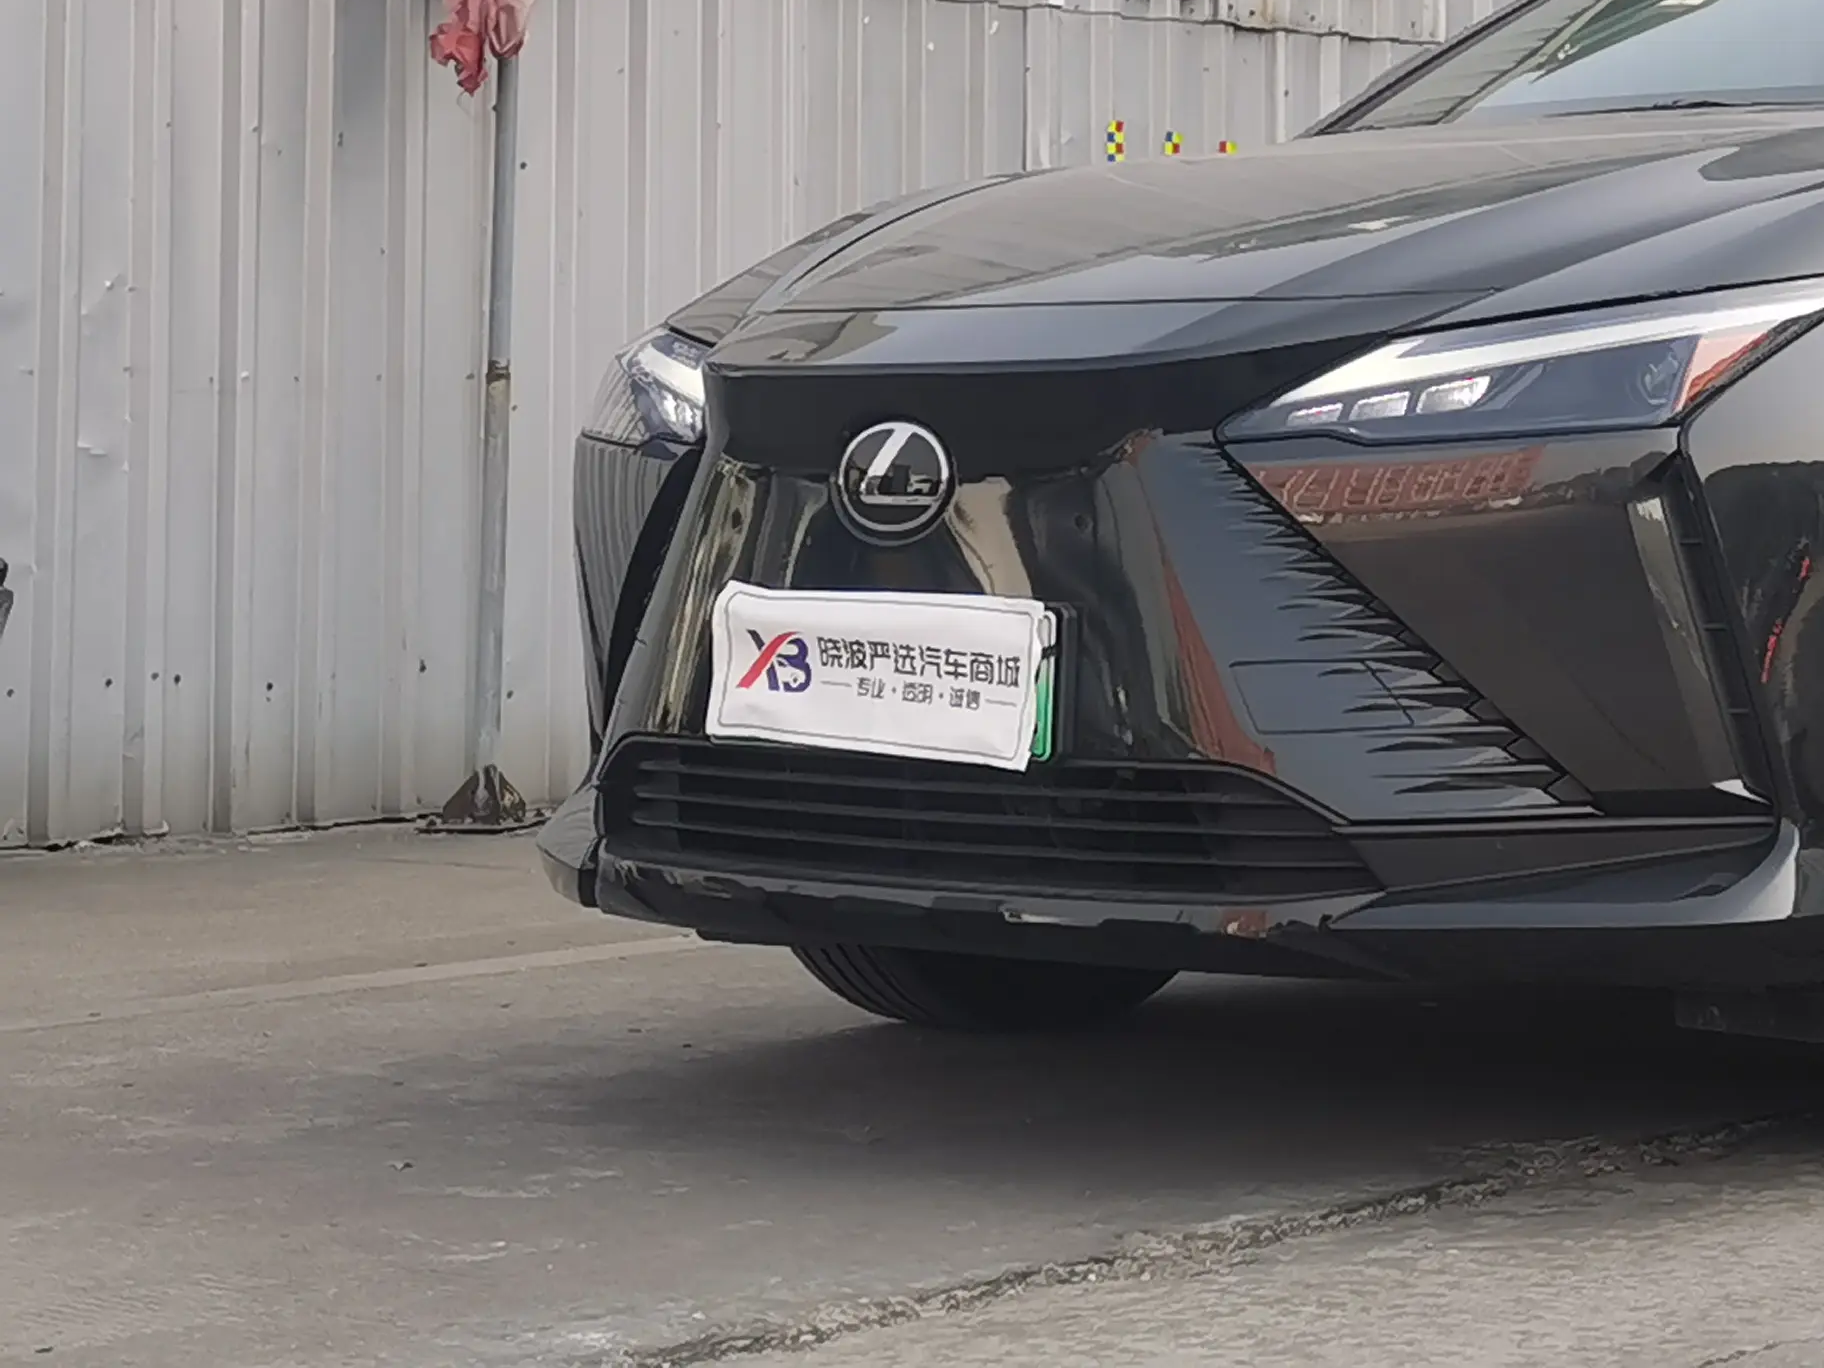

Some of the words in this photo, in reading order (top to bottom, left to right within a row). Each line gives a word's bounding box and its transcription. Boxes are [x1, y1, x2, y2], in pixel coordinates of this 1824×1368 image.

[816, 635, 1021, 689] 晓波严选汽车商城
